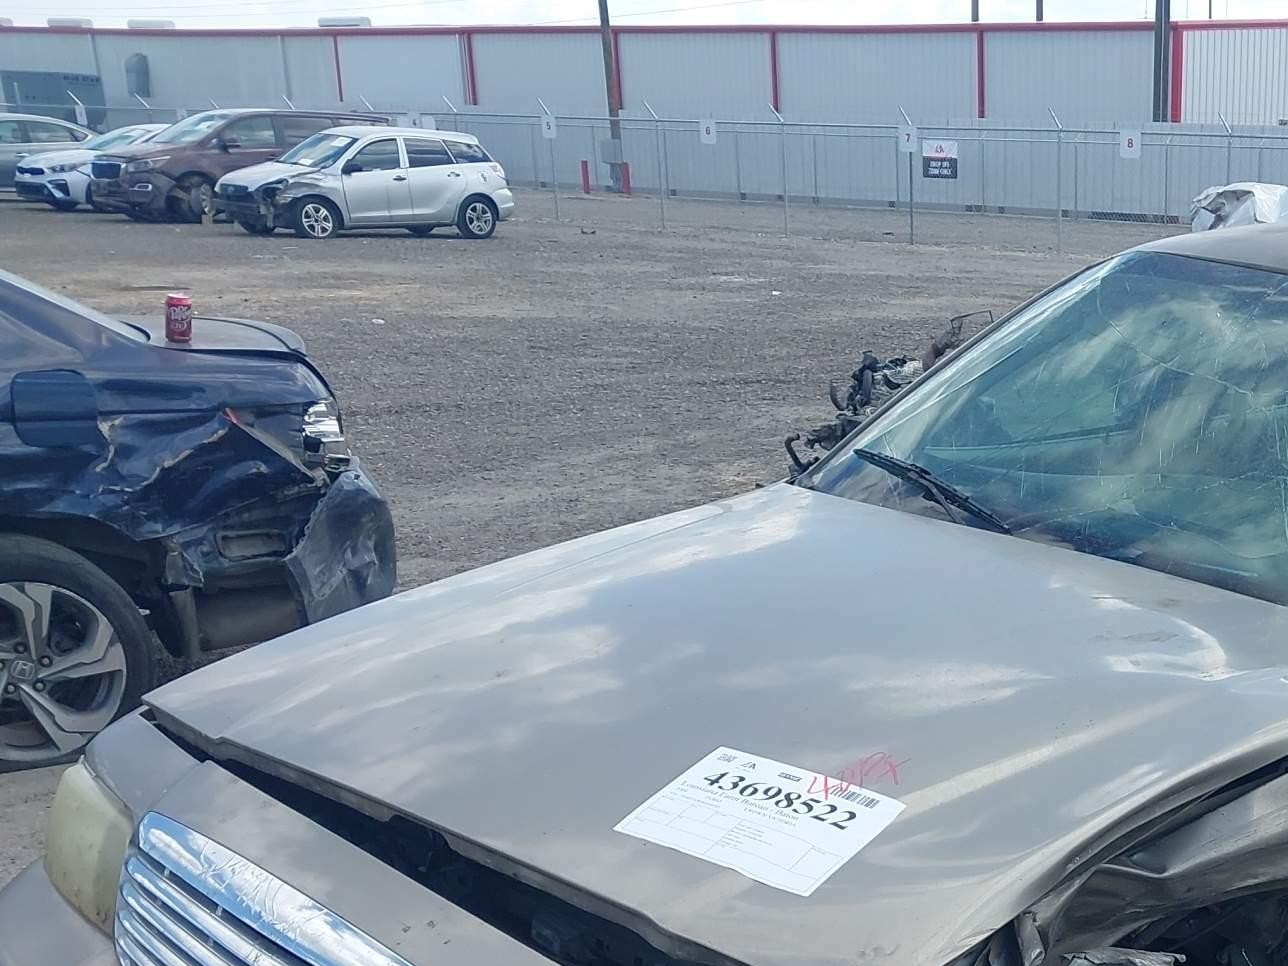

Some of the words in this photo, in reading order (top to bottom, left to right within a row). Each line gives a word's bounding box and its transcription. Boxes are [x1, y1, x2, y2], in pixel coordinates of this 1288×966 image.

[546, 121, 551, 130] 5
[705, 126, 711, 135] 6
[905, 133, 911, 143] 7
[1127, 138, 1133, 148] 8
[703, 771, 857, 831] 43698522
